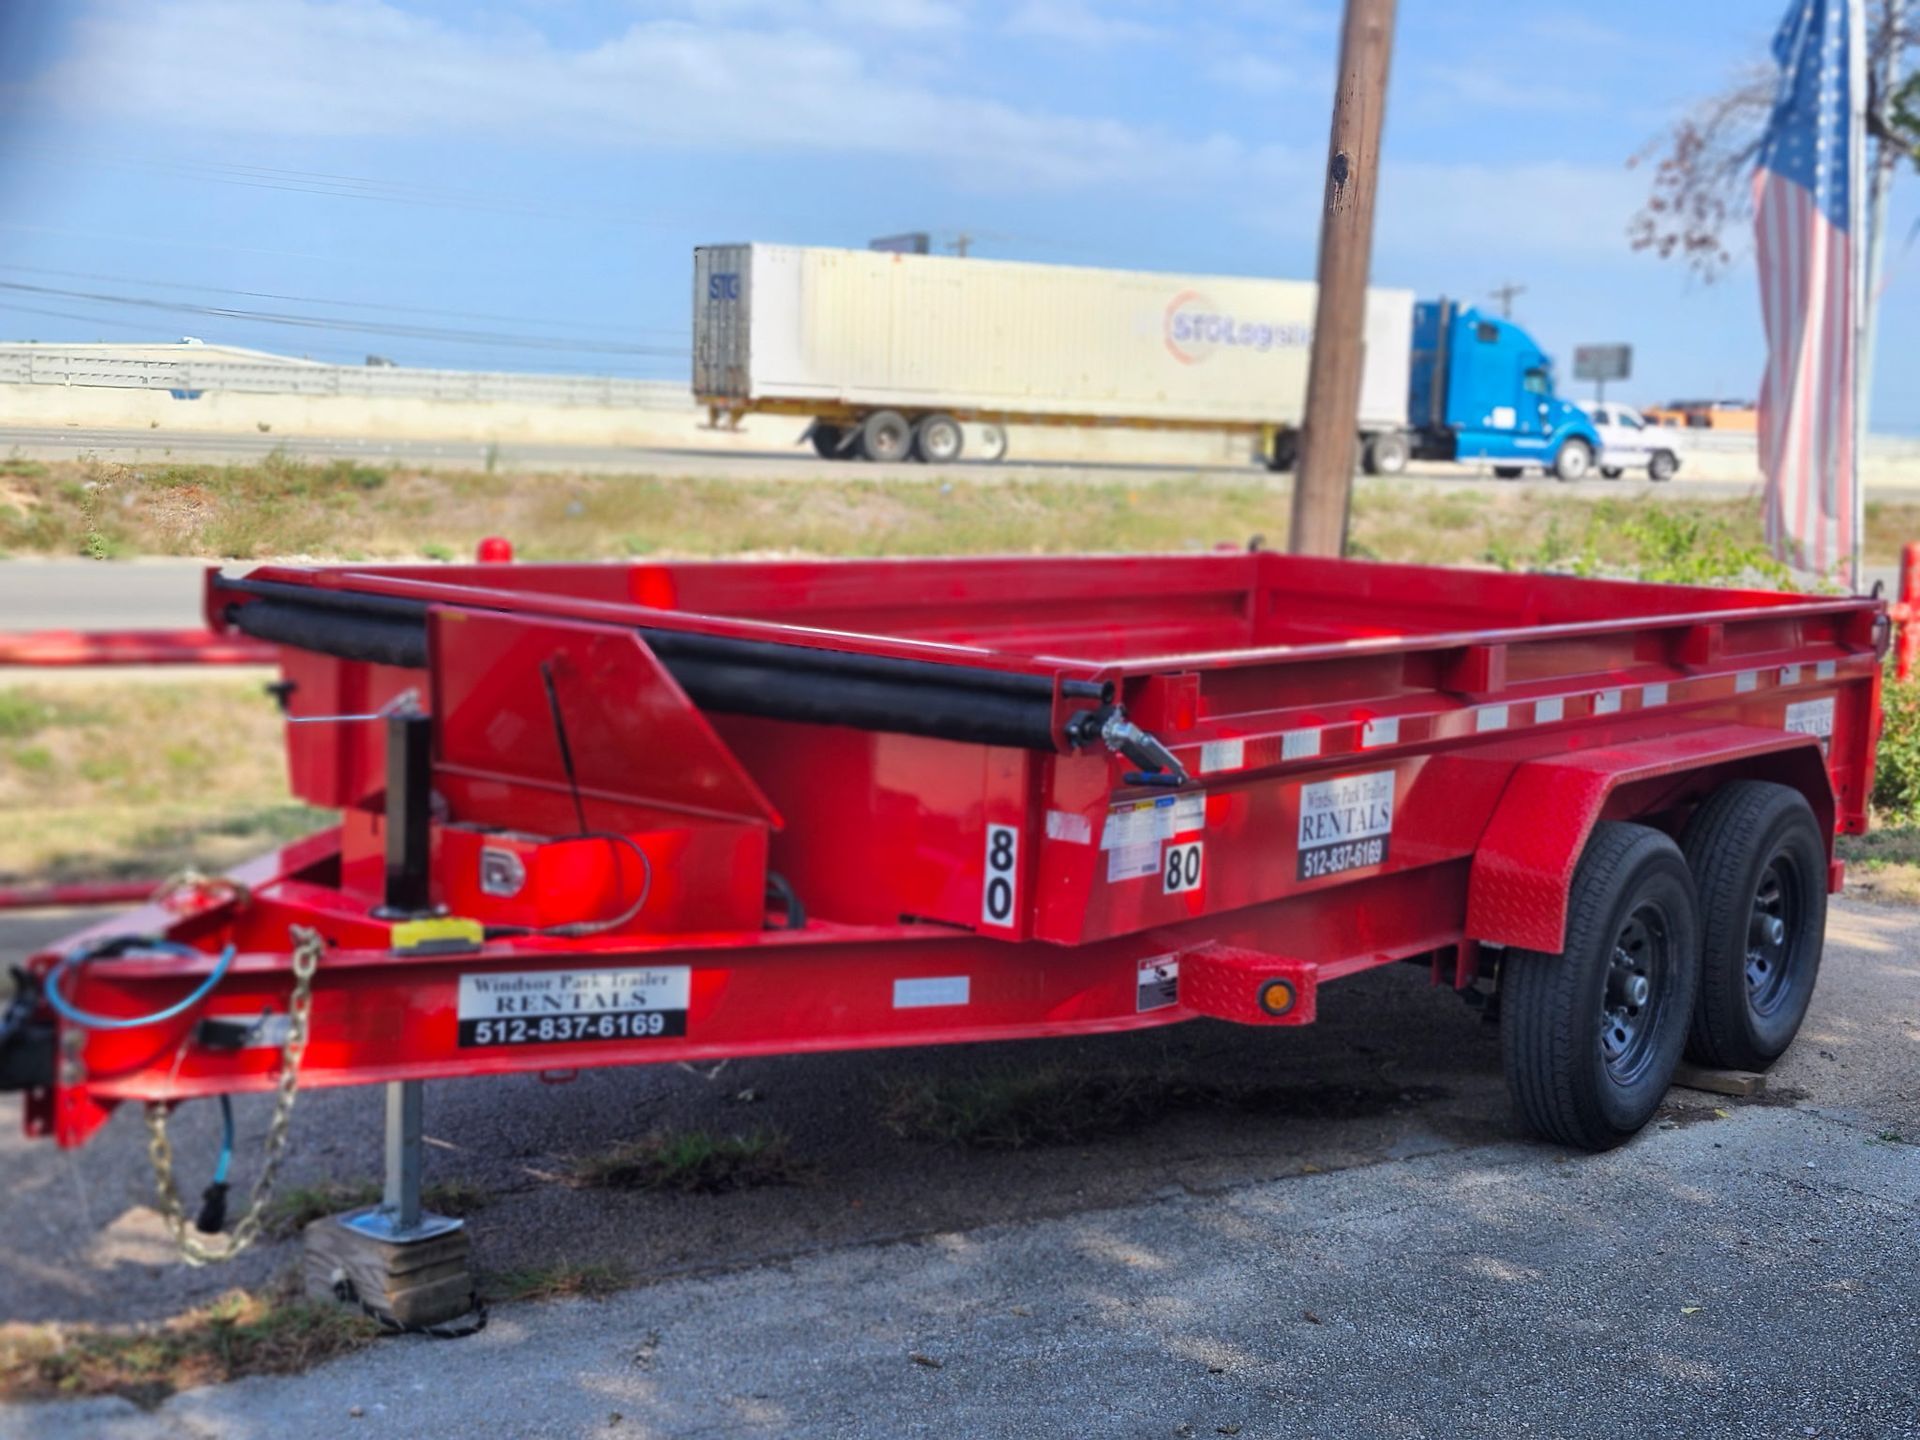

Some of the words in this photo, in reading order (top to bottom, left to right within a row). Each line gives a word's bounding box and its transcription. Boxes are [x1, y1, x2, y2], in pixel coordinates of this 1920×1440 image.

[1301, 801, 1390, 842] RENTALS
[1166, 845, 1201, 890] 80
[1303, 838, 1383, 878] 512-837-6169
[474, 975, 552, 993] Windsor
[560, 973, 599, 990] Park
[610, 970, 669, 988] Trailer
[496, 988, 648, 1014] RENTALS
[475, 1013, 665, 1044] 512-837-6169
